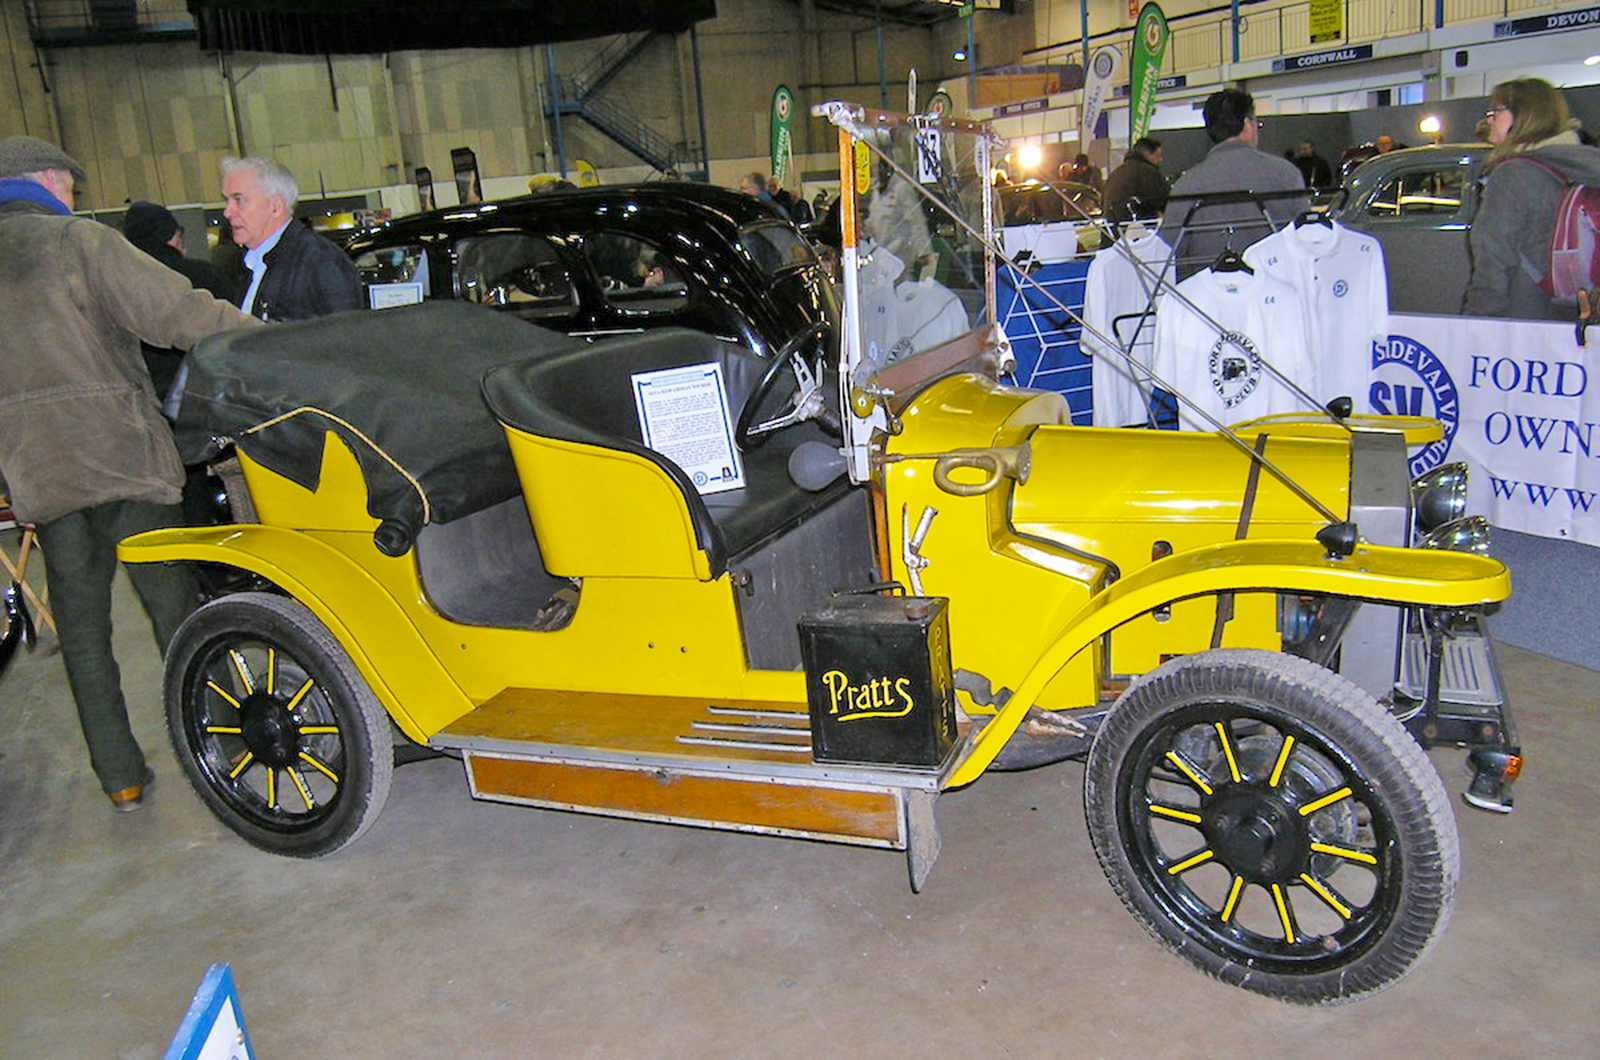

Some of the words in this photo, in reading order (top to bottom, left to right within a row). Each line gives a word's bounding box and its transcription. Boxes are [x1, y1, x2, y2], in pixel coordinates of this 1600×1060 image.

[1547, 9, 1600, 28] DEVON
[1297, 49, 1357, 66] CORNWALL
[1468, 354, 1588, 398] FORD
[1484, 411, 1600, 459] OWN
[822, 670, 914, 722] Pratts
